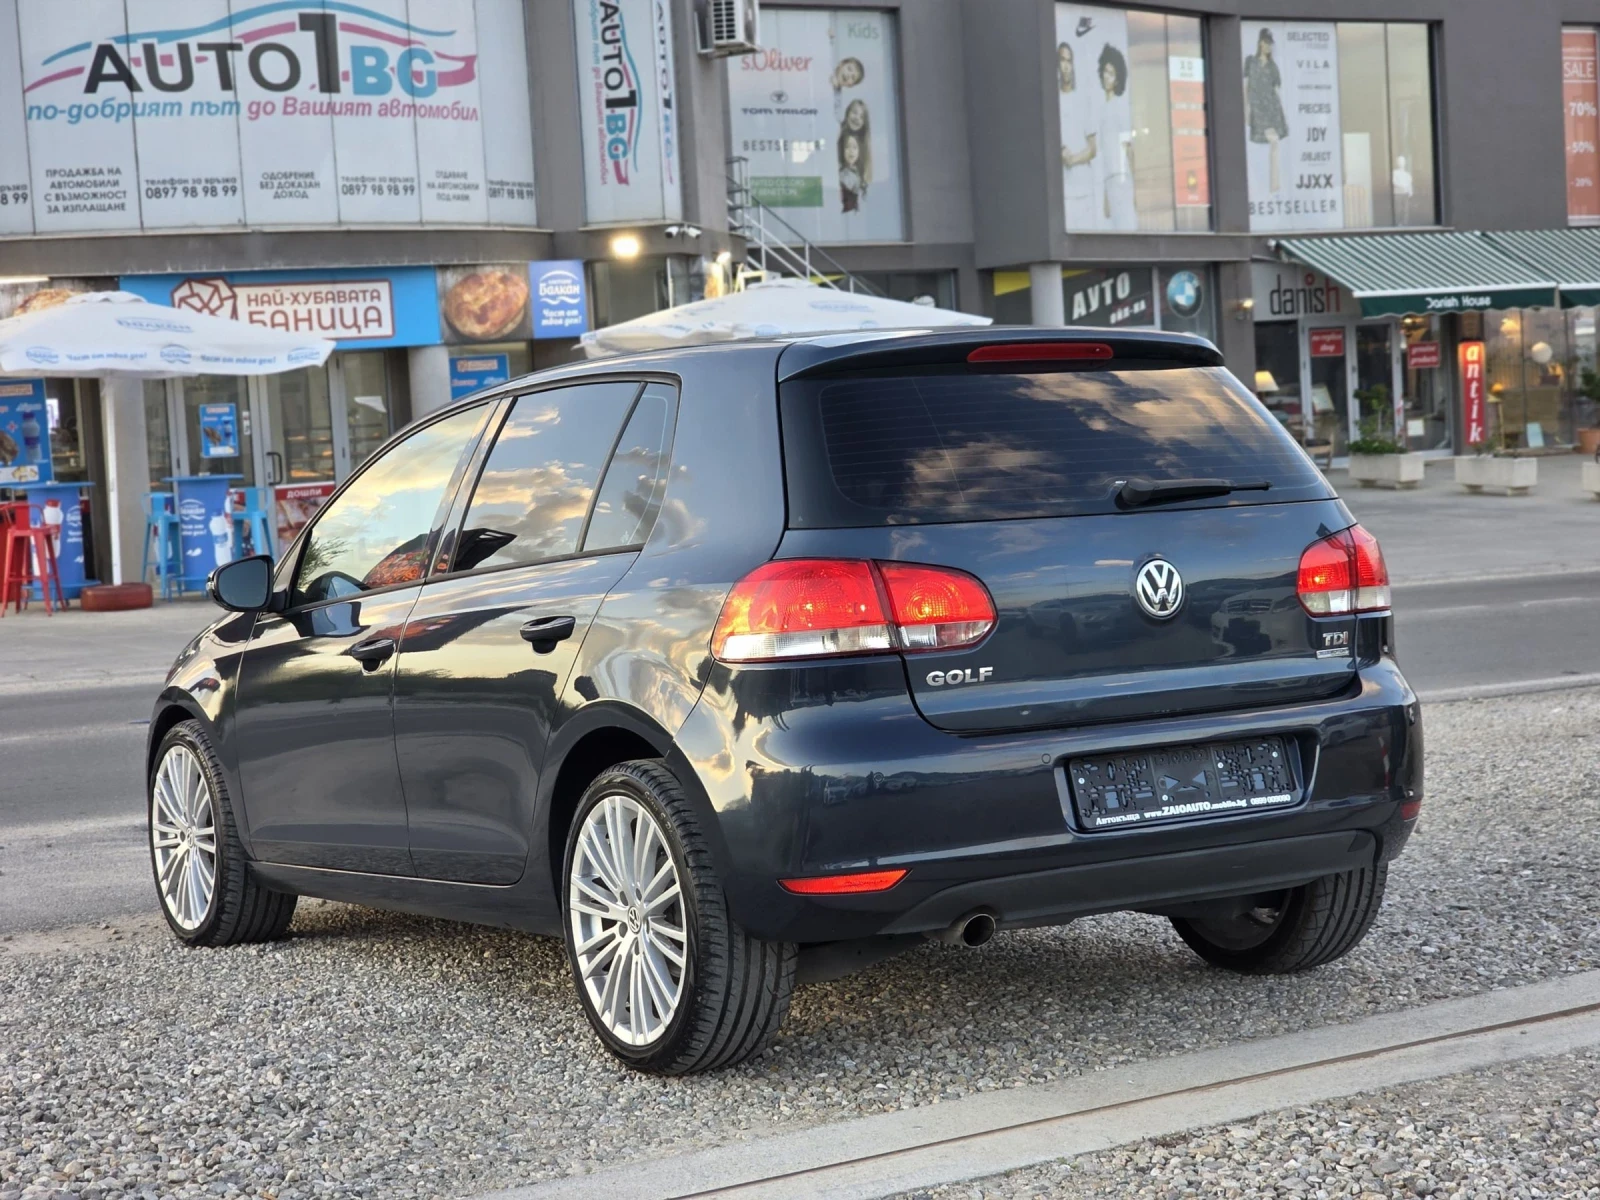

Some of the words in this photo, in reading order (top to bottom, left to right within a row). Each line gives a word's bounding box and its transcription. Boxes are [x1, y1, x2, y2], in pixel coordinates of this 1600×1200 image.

[847, 22, 880, 39] Kids
[1287, 32, 1330, 41] SELECTED
[1297, 60, 1331, 69] VILA
[1563, 61, 1595, 78] SALE
[28, 97, 182, 124] по-добрият
[190, 100, 241, 116] път
[248, 101, 276, 120] до
[282, 97, 372, 116] Вашият
[377, 99, 479, 121] автомобил
[741, 107, 773, 115] TOM
[775, 107, 818, 115] TAILOR
[1299, 103, 1332, 114] PIECES
[1307, 127, 1327, 142] JDY
[45, 168, 104, 179] ПРОДАЖБА
[107, 167, 122, 176] НА
[261, 171, 315, 181] ОДОБРЕНИЕ
[50, 179, 119, 189] АВТОМОБИЛИ
[145, 178, 189, 187] телефон
[259, 181, 276, 190] БЕЗ
[277, 180, 321, 191] ДОКАЗАН
[1296, 174, 1333, 189] JJXX
[44, 193, 52, 202] С
[55, 190, 127, 202] ВЪЗМОЖНОСТ
[145, 187, 178, 200] 0897
[181, 186, 199, 199] 98
[202, 185, 218, 198] 98
[222, 185, 238, 198] 99
[273, 190, 309, 200] ДОХОД
[341, 183, 368, 197] 0897
[371, 183, 385, 197] 98
[387, 183, 401, 197] 98
[402, 184, 416, 197] 99
[12, 192, 29, 204] 99
[47, 205, 60, 214] ЗА
[63, 203, 126, 214] ИЗПЛАЩАНЕ
[1249, 200, 1337, 216] BESTSELLER
[247, 288, 381, 307] НАЙ-ХУБАВАТА
[1270, 272, 1341, 315] danish
[1462, 296, 1492, 307] House
[248, 305, 382, 334] БАНИЦА
[1465, 344, 1483, 443] antik
[1322, 630, 1349, 647] TDI
[926, 666, 994, 687] GOLF
